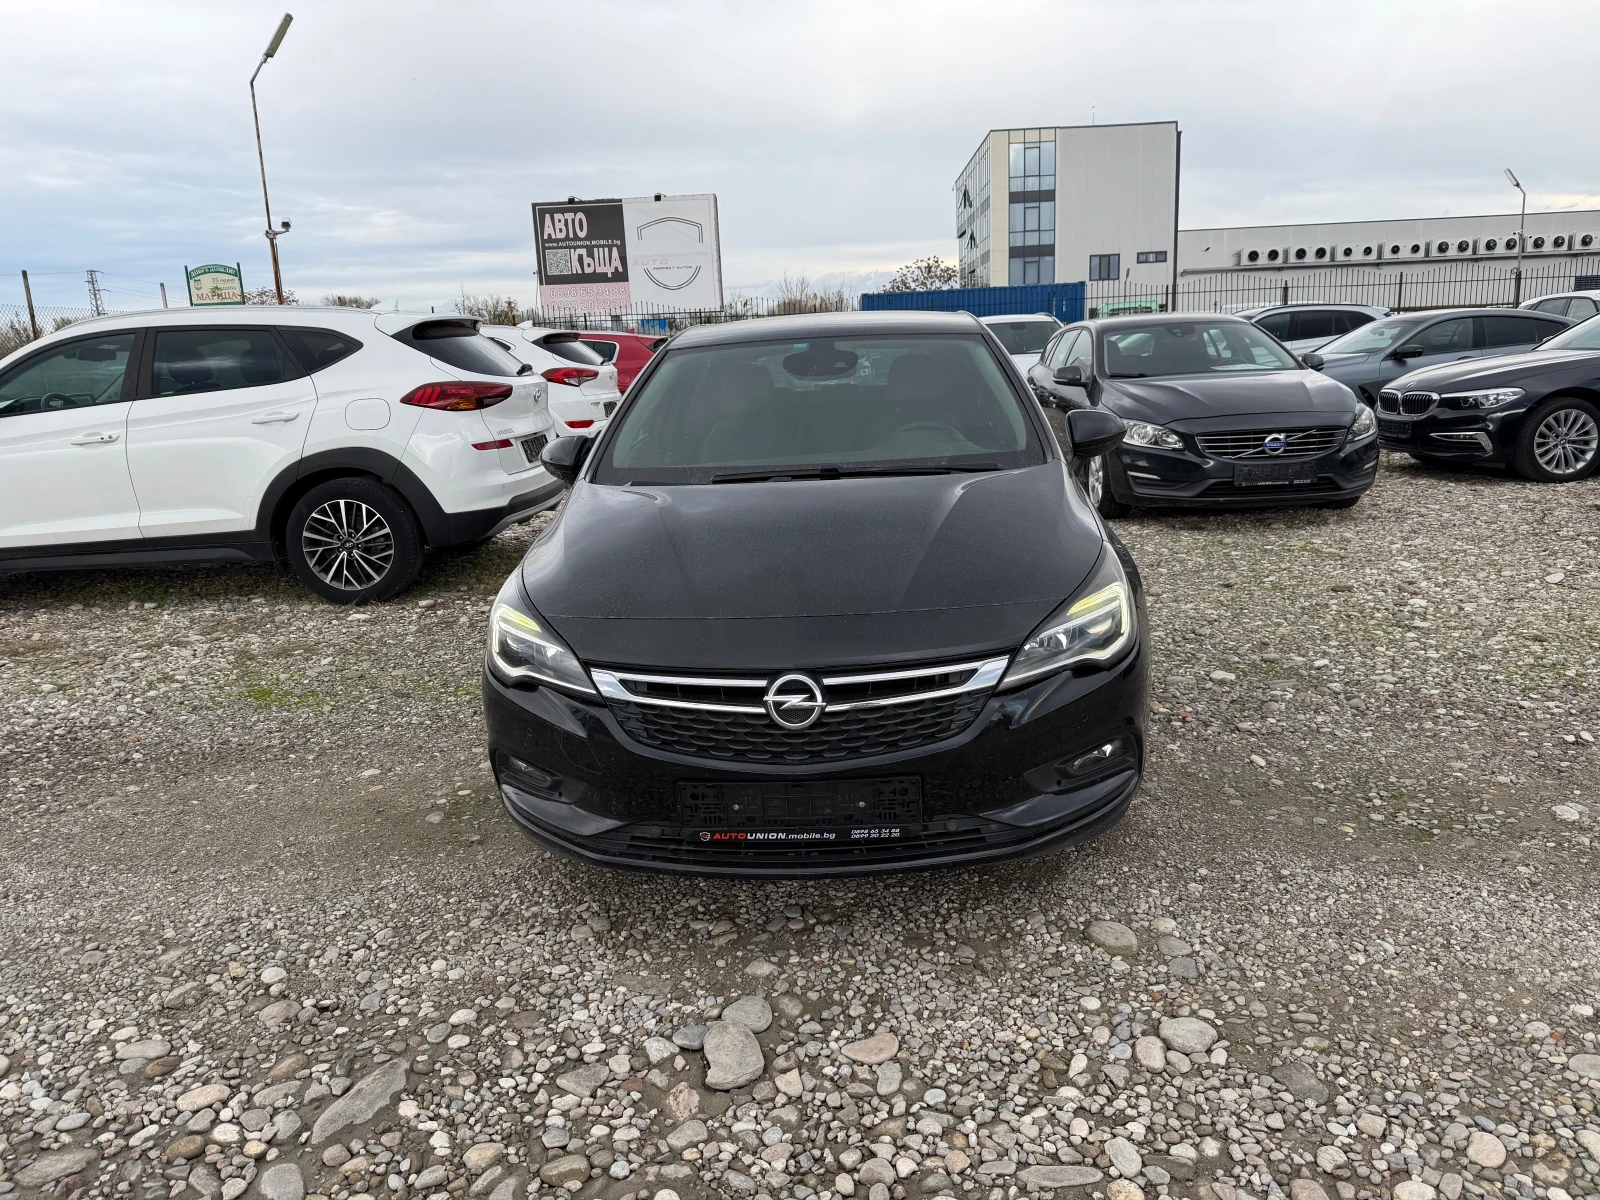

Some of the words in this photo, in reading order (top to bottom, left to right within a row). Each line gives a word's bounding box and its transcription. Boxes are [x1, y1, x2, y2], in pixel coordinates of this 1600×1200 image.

[544, 212, 587, 239] АВТО
[571, 246, 623, 277] КЪЩА
[580, 286, 594, 297] 65
[596, 286, 610, 296] 34
[612, 285, 626, 295] 88
[581, 300, 594, 310] 20
[597, 299, 610, 309] 22
[613, 298, 627, 309] 20
